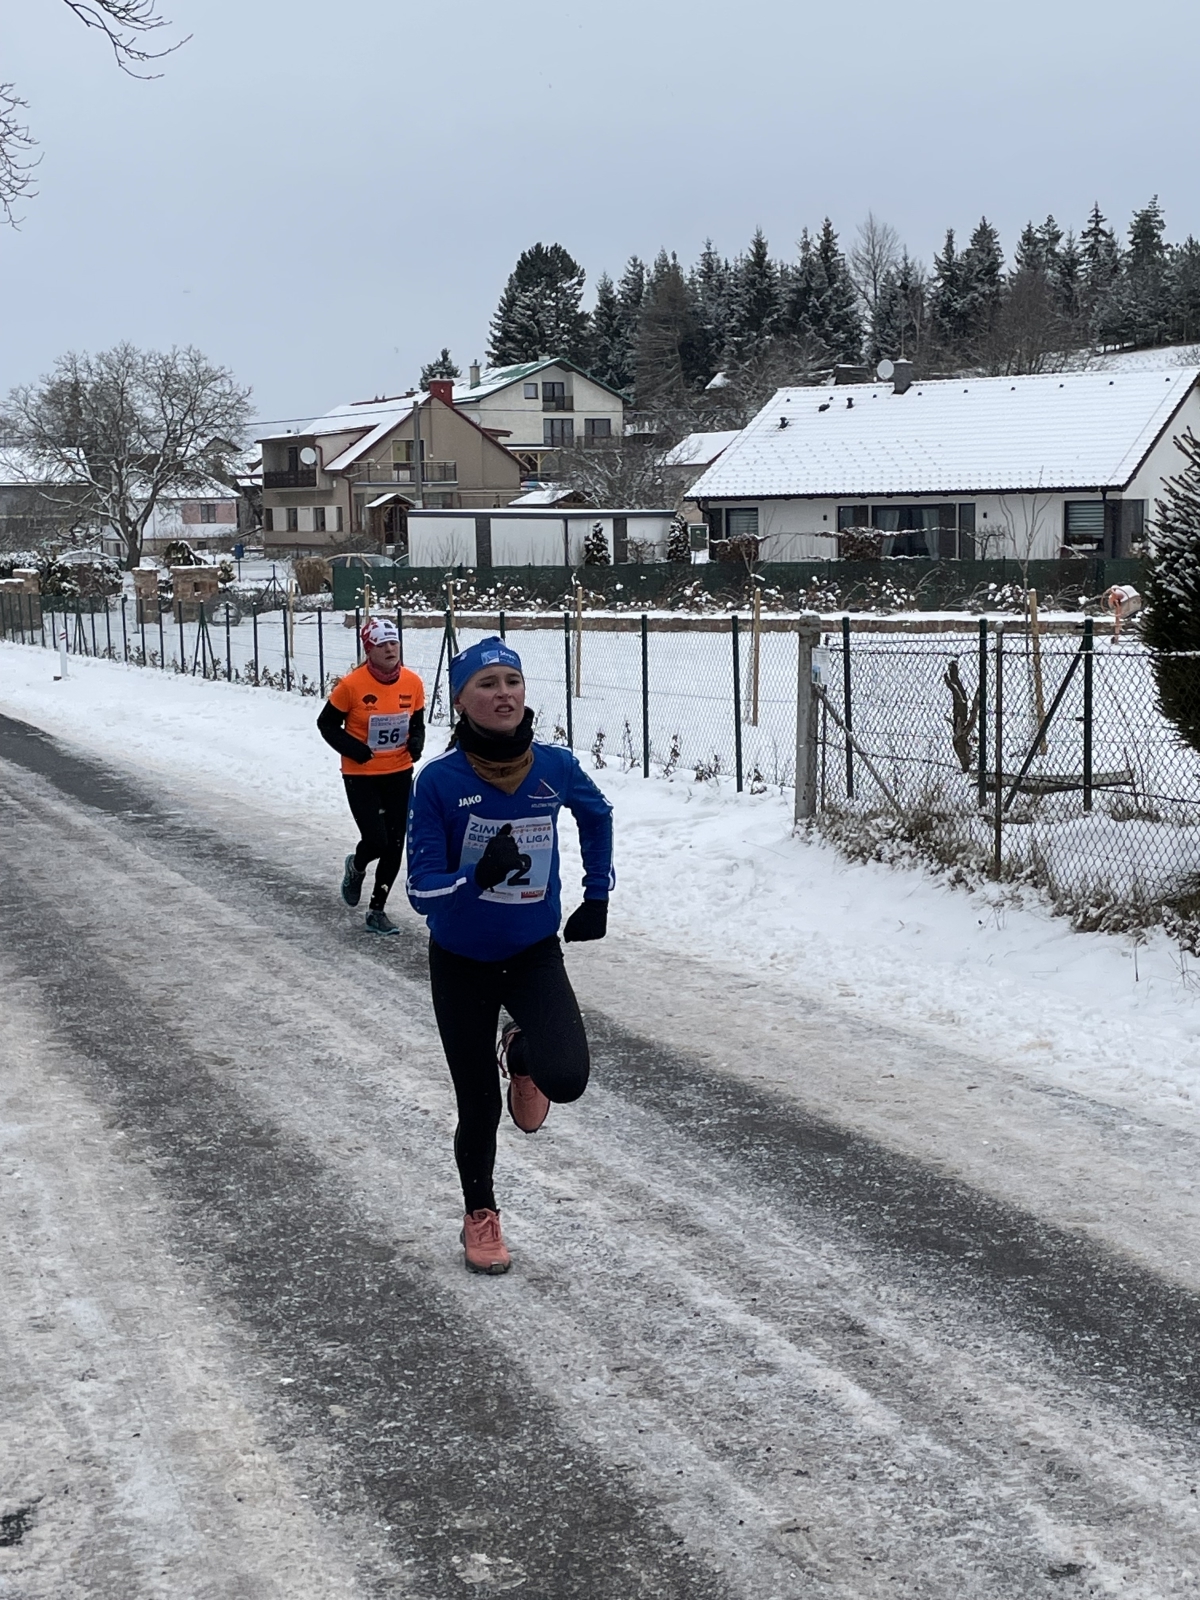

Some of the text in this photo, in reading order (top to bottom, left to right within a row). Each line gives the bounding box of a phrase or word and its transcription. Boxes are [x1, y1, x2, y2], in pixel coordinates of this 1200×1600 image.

[377, 728, 400, 745] 56
[458, 794, 482, 807] JAKO
[526, 834, 550, 844] LIGA
